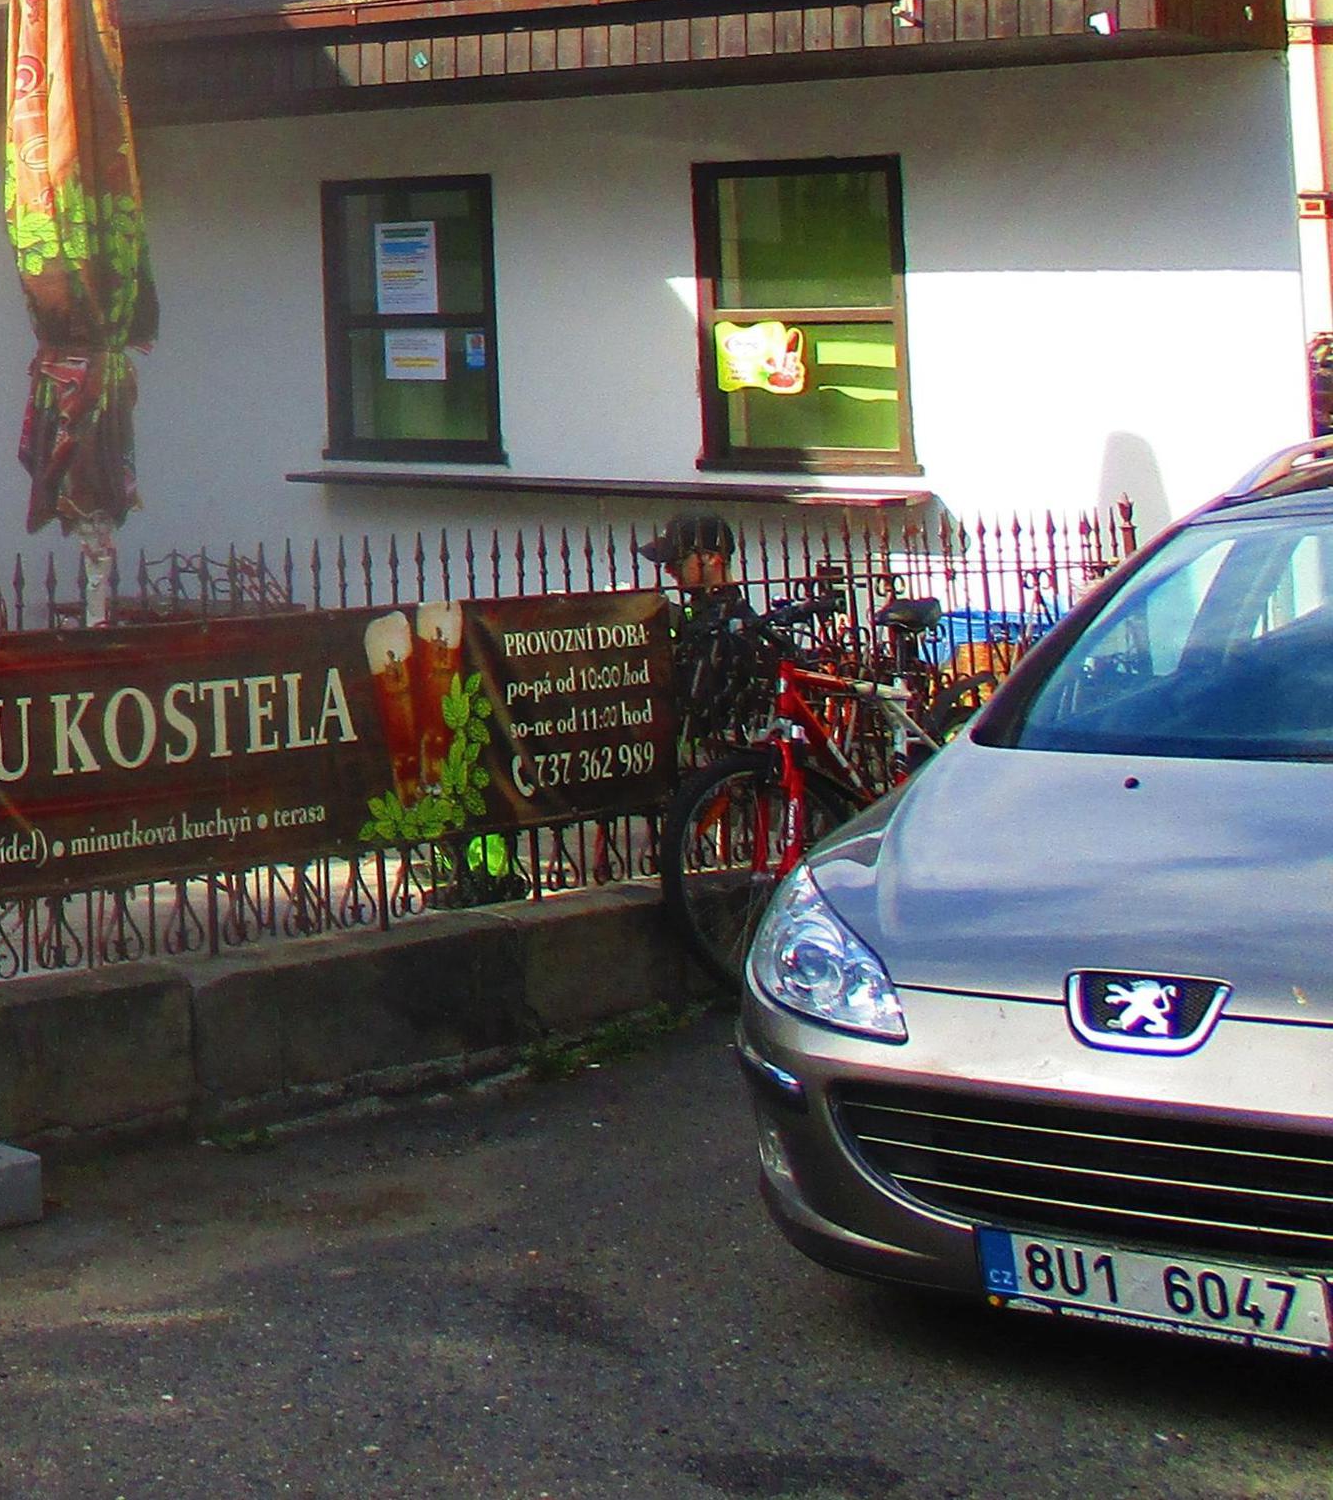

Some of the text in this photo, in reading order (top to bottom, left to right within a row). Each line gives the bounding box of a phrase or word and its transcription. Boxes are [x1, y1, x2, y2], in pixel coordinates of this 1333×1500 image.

[504, 622, 594, 657] PROVOZNÍ
[506, 659, 650, 705] po-pá od 10:00 hod
[50, 667, 358, 776] KOSTELA
[510, 698, 653, 739] so-ne od 11:00 hod
[534, 741, 655, 787] 737 362 989
[70, 816, 177, 856] minutková
[182, 807, 252, 843] kuchyň
[273, 804, 326, 828] terasa
[989, 1269, 1014, 1286] CZ
[1025, 1242, 1297, 1332] 8U1 6047
